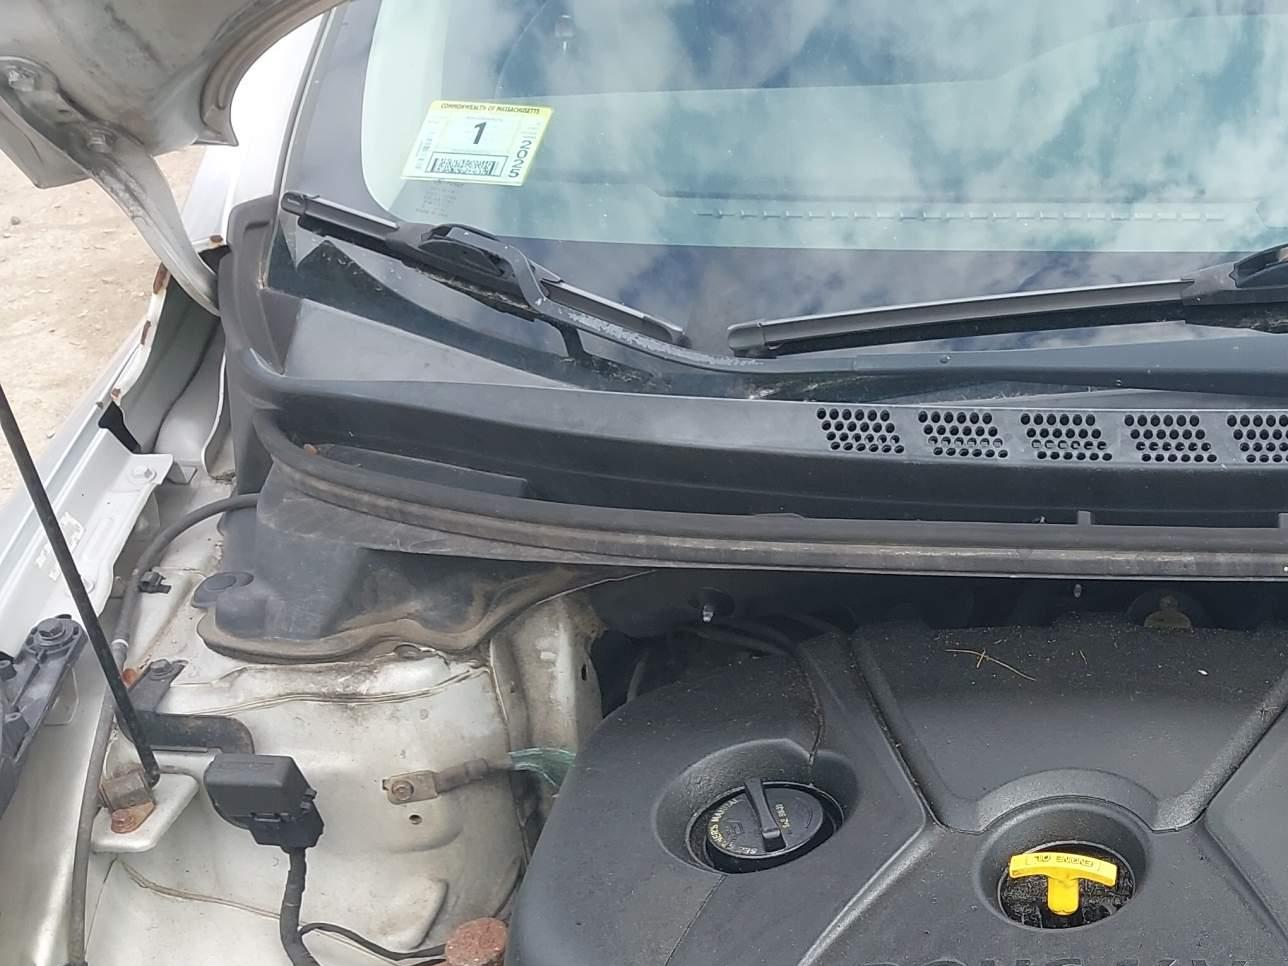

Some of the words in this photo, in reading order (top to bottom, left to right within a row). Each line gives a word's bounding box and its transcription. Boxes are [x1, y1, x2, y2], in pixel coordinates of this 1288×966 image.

[440, 102, 488, 112] COMMONWEALTH
[488, 104, 496, 112] OF
[473, 121, 487, 145] 1
[507, 139, 533, 178] 2025
